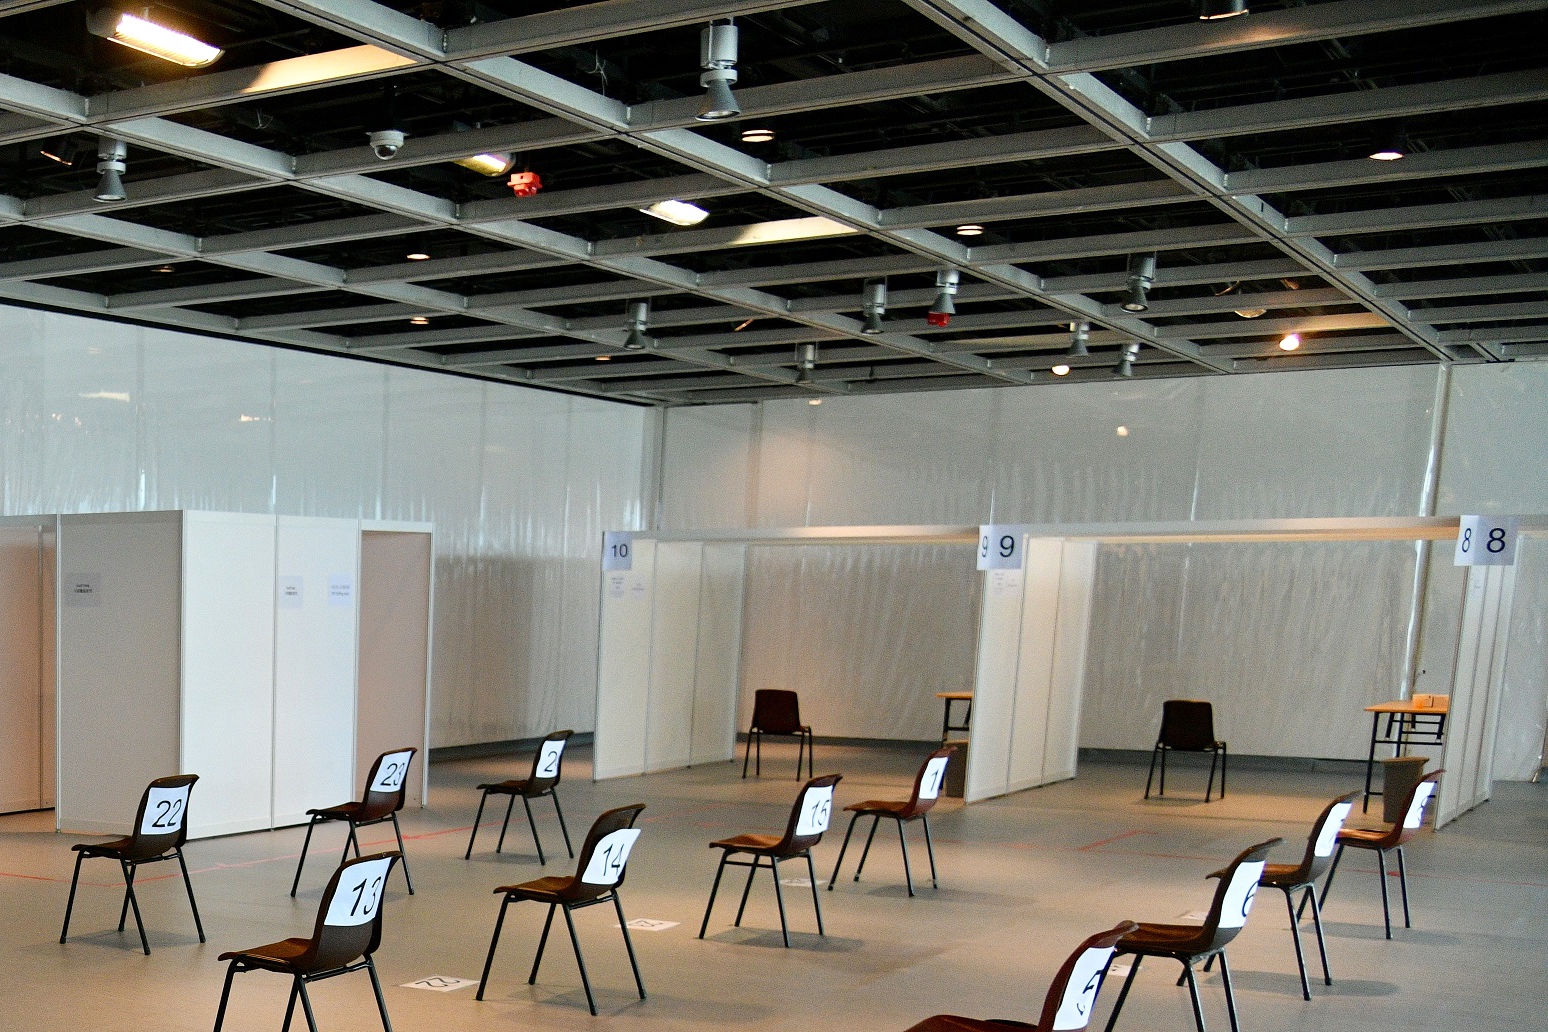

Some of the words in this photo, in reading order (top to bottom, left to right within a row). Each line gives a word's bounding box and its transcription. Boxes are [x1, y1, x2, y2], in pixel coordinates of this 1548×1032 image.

[611, 543, 628, 558] 10
[981, 535, 988, 558] 9
[999, 535, 1015, 558] 9
[1461, 527, 1472, 553] 8
[1486, 527, 1506, 553] 8
[544, 750, 557, 773] 2
[380, 762, 406, 787] 23
[151, 798, 183, 828] 22
[811, 799, 830, 828] 15
[603, 843, 625, 877] 14
[349, 875, 382, 917] 13
[414, 977, 461, 988] 22
